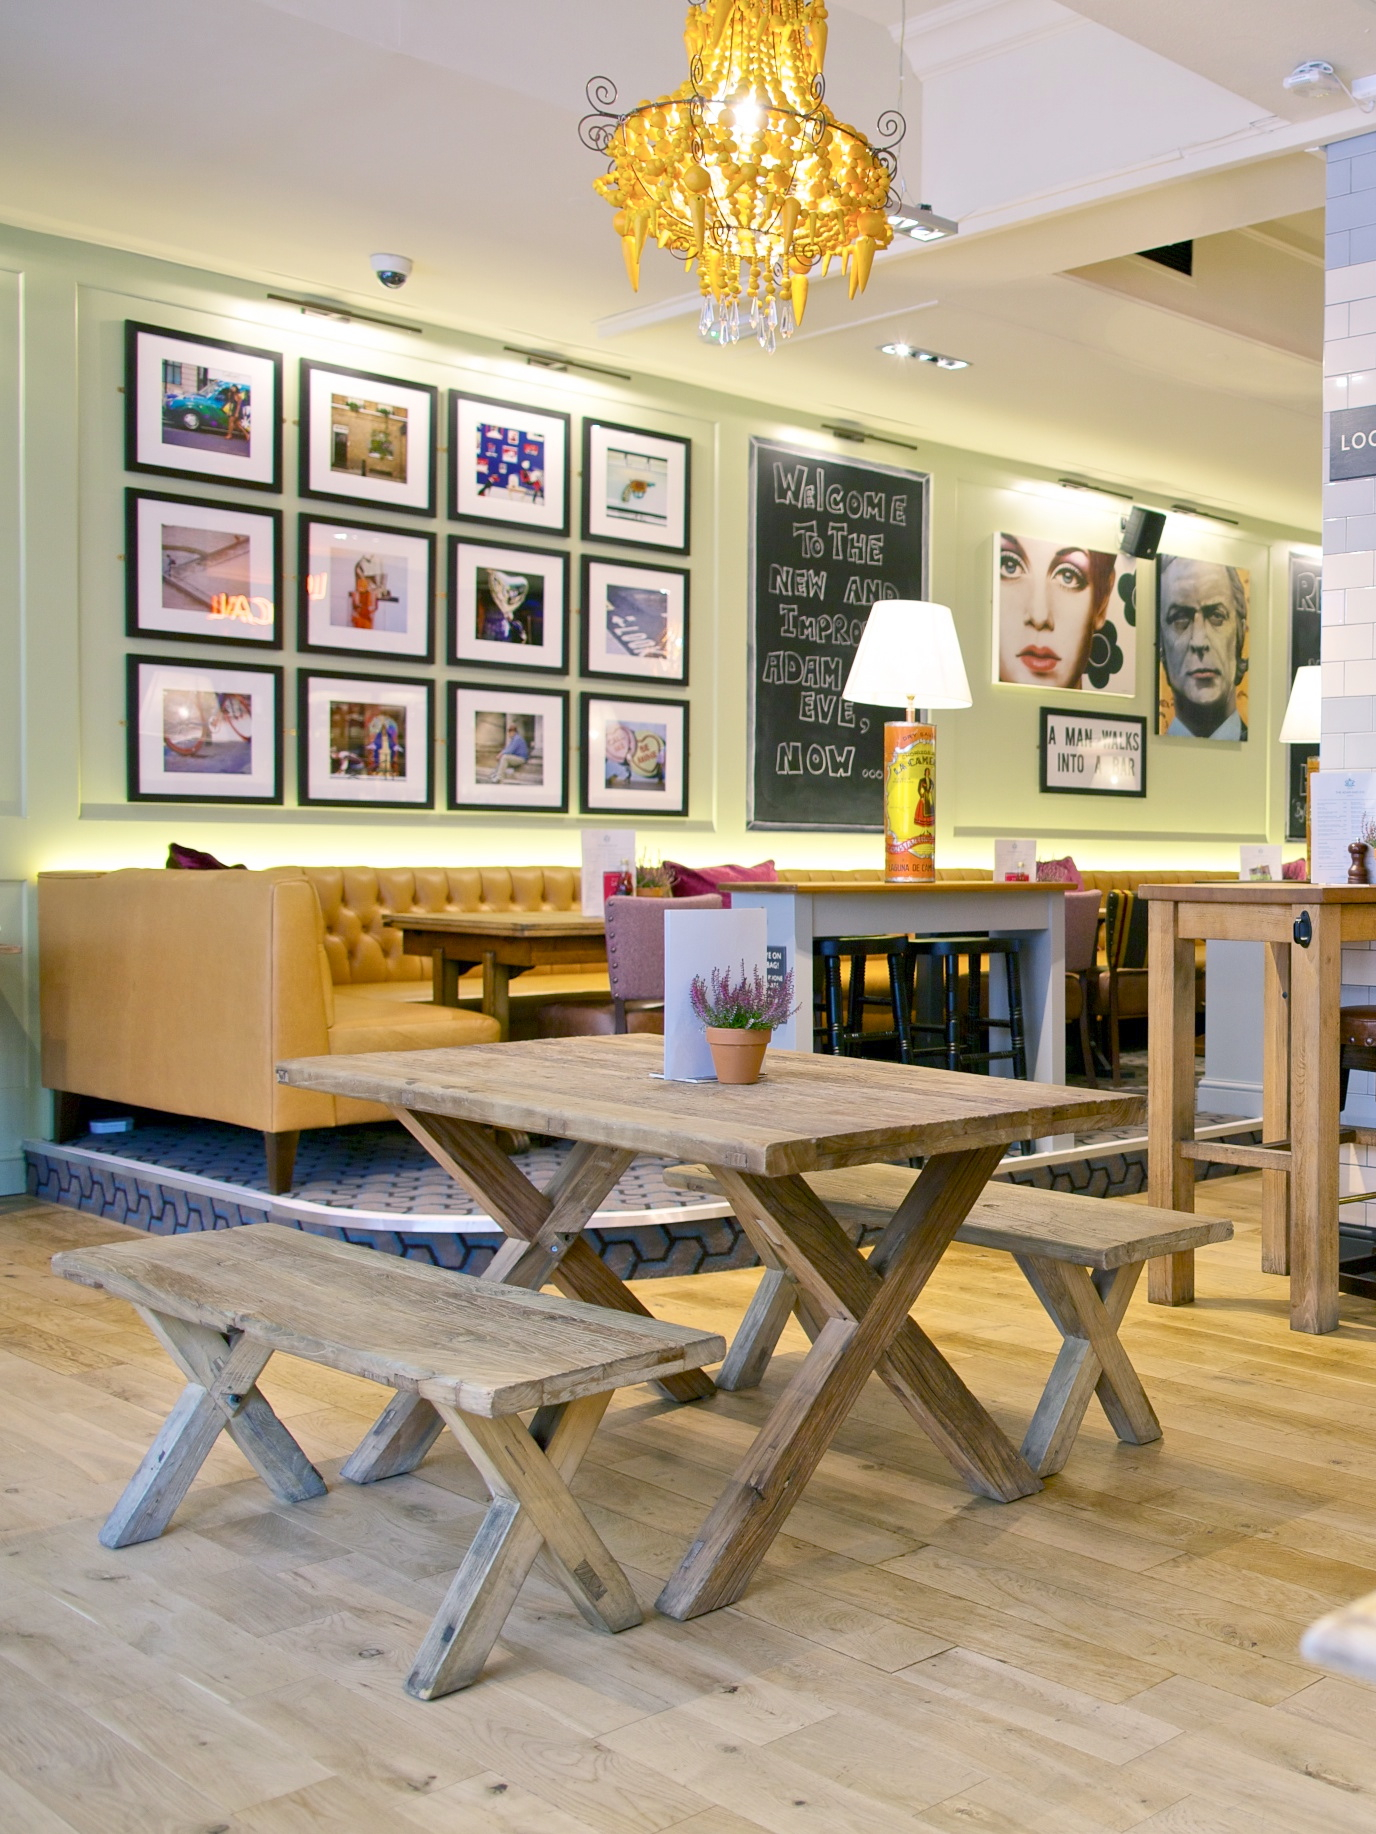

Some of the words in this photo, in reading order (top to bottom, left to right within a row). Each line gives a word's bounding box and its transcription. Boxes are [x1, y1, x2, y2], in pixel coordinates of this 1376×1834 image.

[827, 522, 884, 565] THE
[768, 563, 827, 601] NEW
[843, 576, 899, 606] AND
[779, 603, 869, 647] IMPRO
[762, 651, 842, 690] ADAM
[1048, 725, 1056, 745] A
[1065, 726, 1093, 747] MAN
[1102, 729, 1140, 751] WALKS
[775, 742, 856, 777] NOW
[1057, 752, 1084, 773] INTO
[1094, 755, 1102, 775] A
[1112, 756, 1135, 777] BAR
[772, 952, 782, 960] ON
